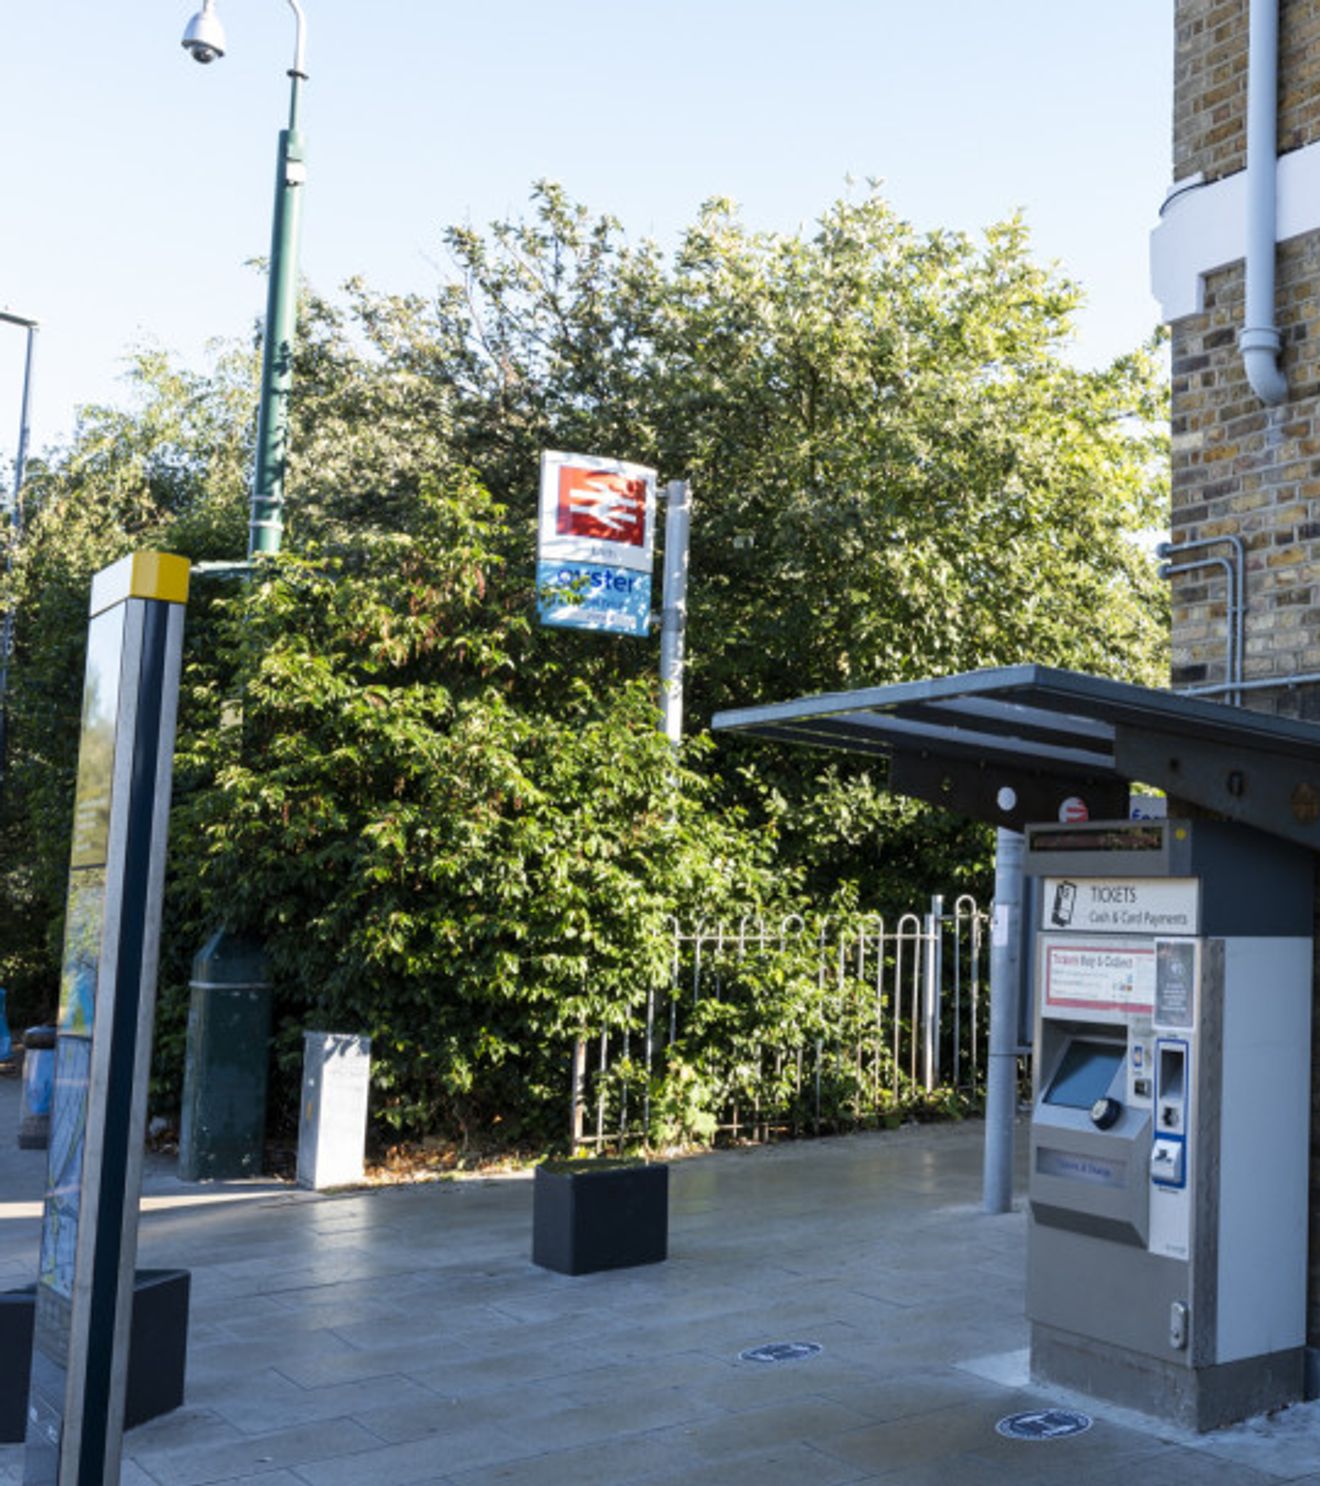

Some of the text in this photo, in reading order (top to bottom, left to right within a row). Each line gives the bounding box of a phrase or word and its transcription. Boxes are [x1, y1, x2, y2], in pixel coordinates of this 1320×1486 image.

[1090, 886, 1137, 904] TICKETS
[1089, 911, 1187, 928] Cash & Card Payments
